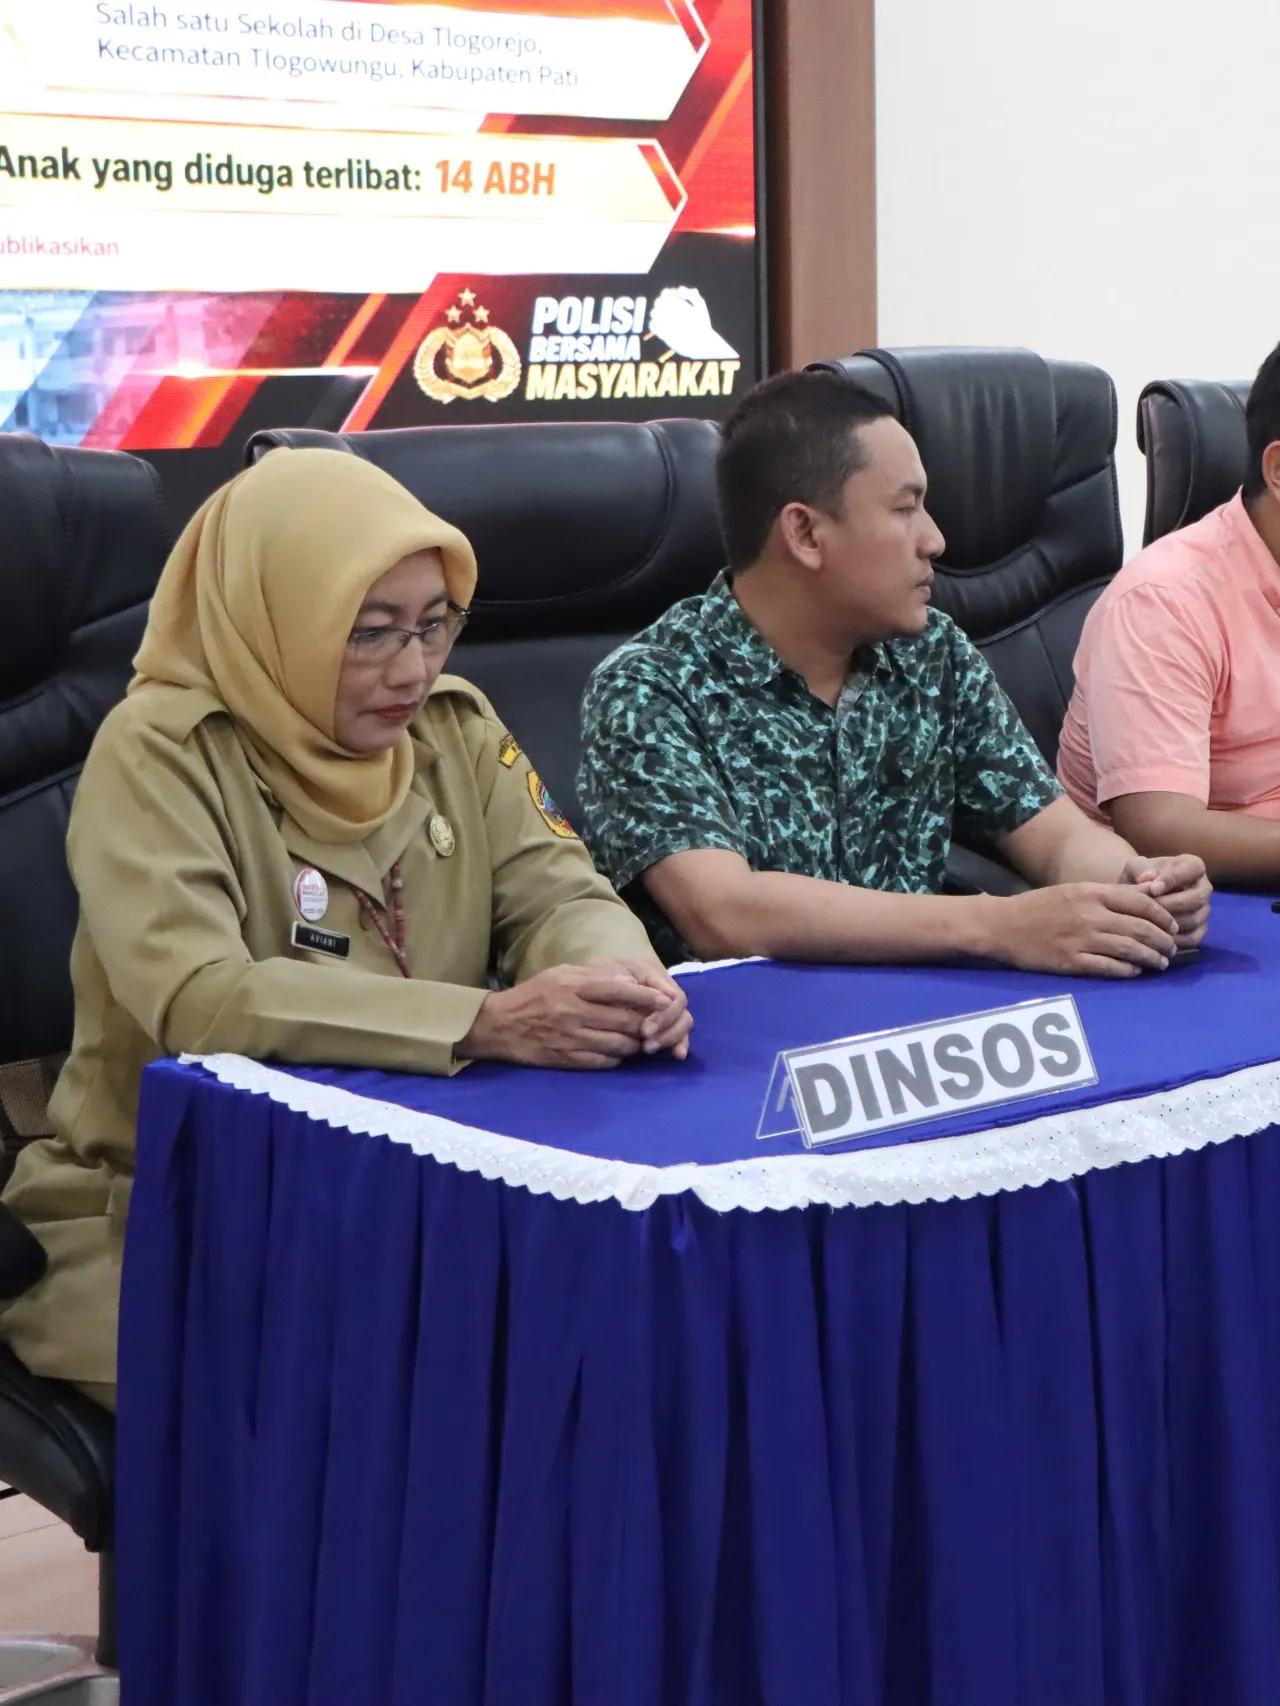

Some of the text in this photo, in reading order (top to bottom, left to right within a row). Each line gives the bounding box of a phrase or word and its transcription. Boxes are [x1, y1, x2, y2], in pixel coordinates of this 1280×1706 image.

[96, 2, 543, 57] Salah satu Sekolah di Desa Tlogorejo,
[97, 37, 579, 87] Kecamatan Tlogowungu, Kabupaten Pati
[0, 145, 556, 196] Anak yang diduga terlibat: 14 ABH
[531, 295, 648, 335] POLISI
[528, 335, 641, 363] BERSAMA
[525, 360, 741, 400] MASYARAKAT
[794, 1012, 1082, 1135] DINSOS
